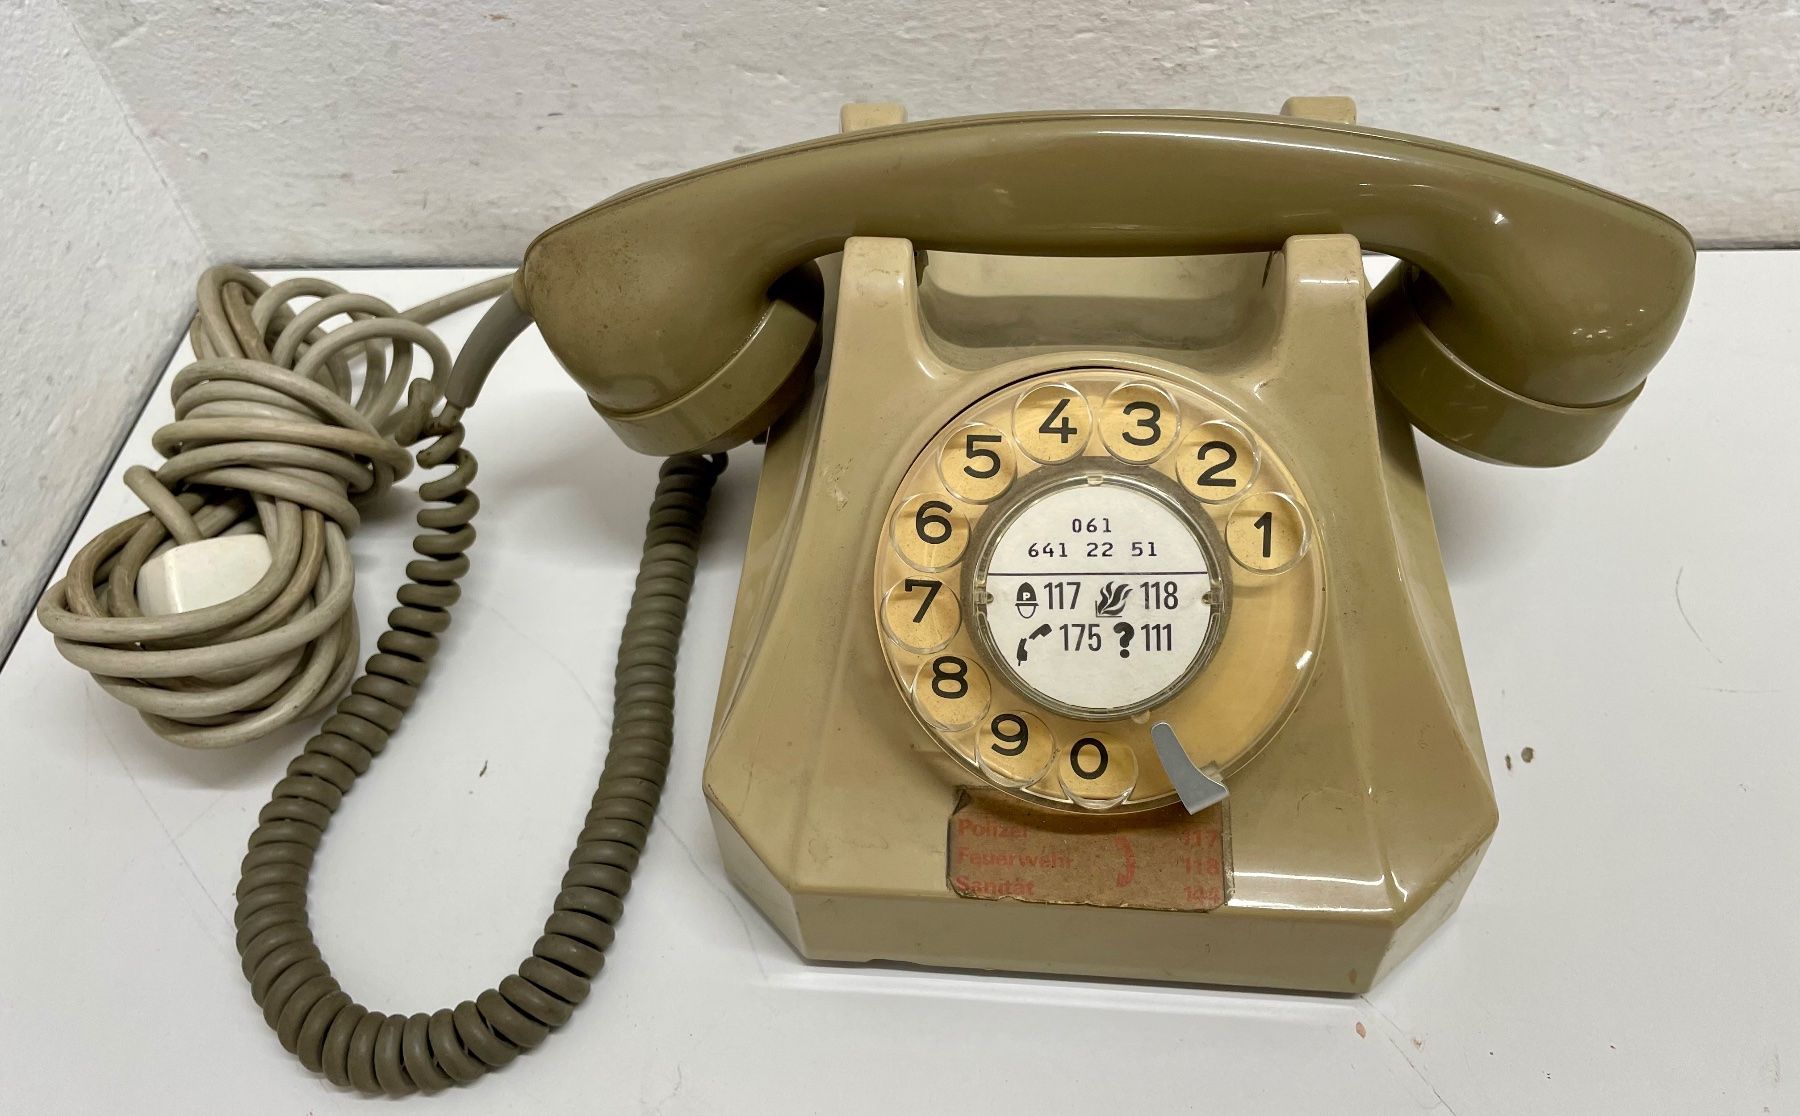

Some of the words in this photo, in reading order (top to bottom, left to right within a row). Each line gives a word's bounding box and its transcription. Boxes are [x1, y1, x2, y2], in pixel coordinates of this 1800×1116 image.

[1038, 398, 1078, 444] 4
[1121, 401, 1161, 446] 3
[963, 434, 1002, 479] 5
[1197, 440, 1237, 487] 2
[915, 501, 953, 545] 6
[1072, 518, 1112, 533] 061
[1253, 511, 1273, 558] 1
[1028, 542, 1068, 558] 641
[1086, 542, 1114, 557] 22
[1131, 541, 1157, 557] 51
[904, 579, 943, 624] 7
[1043, 582, 1081, 610] 117
[1140, 581, 1179, 610] 118
[1059, 623, 1102, 652] 175
[1140, 623, 1172, 652] 111
[931, 655, 969, 699] 8
[990, 713, 1029, 757] 9
[1069, 738, 1109, 780] 0
